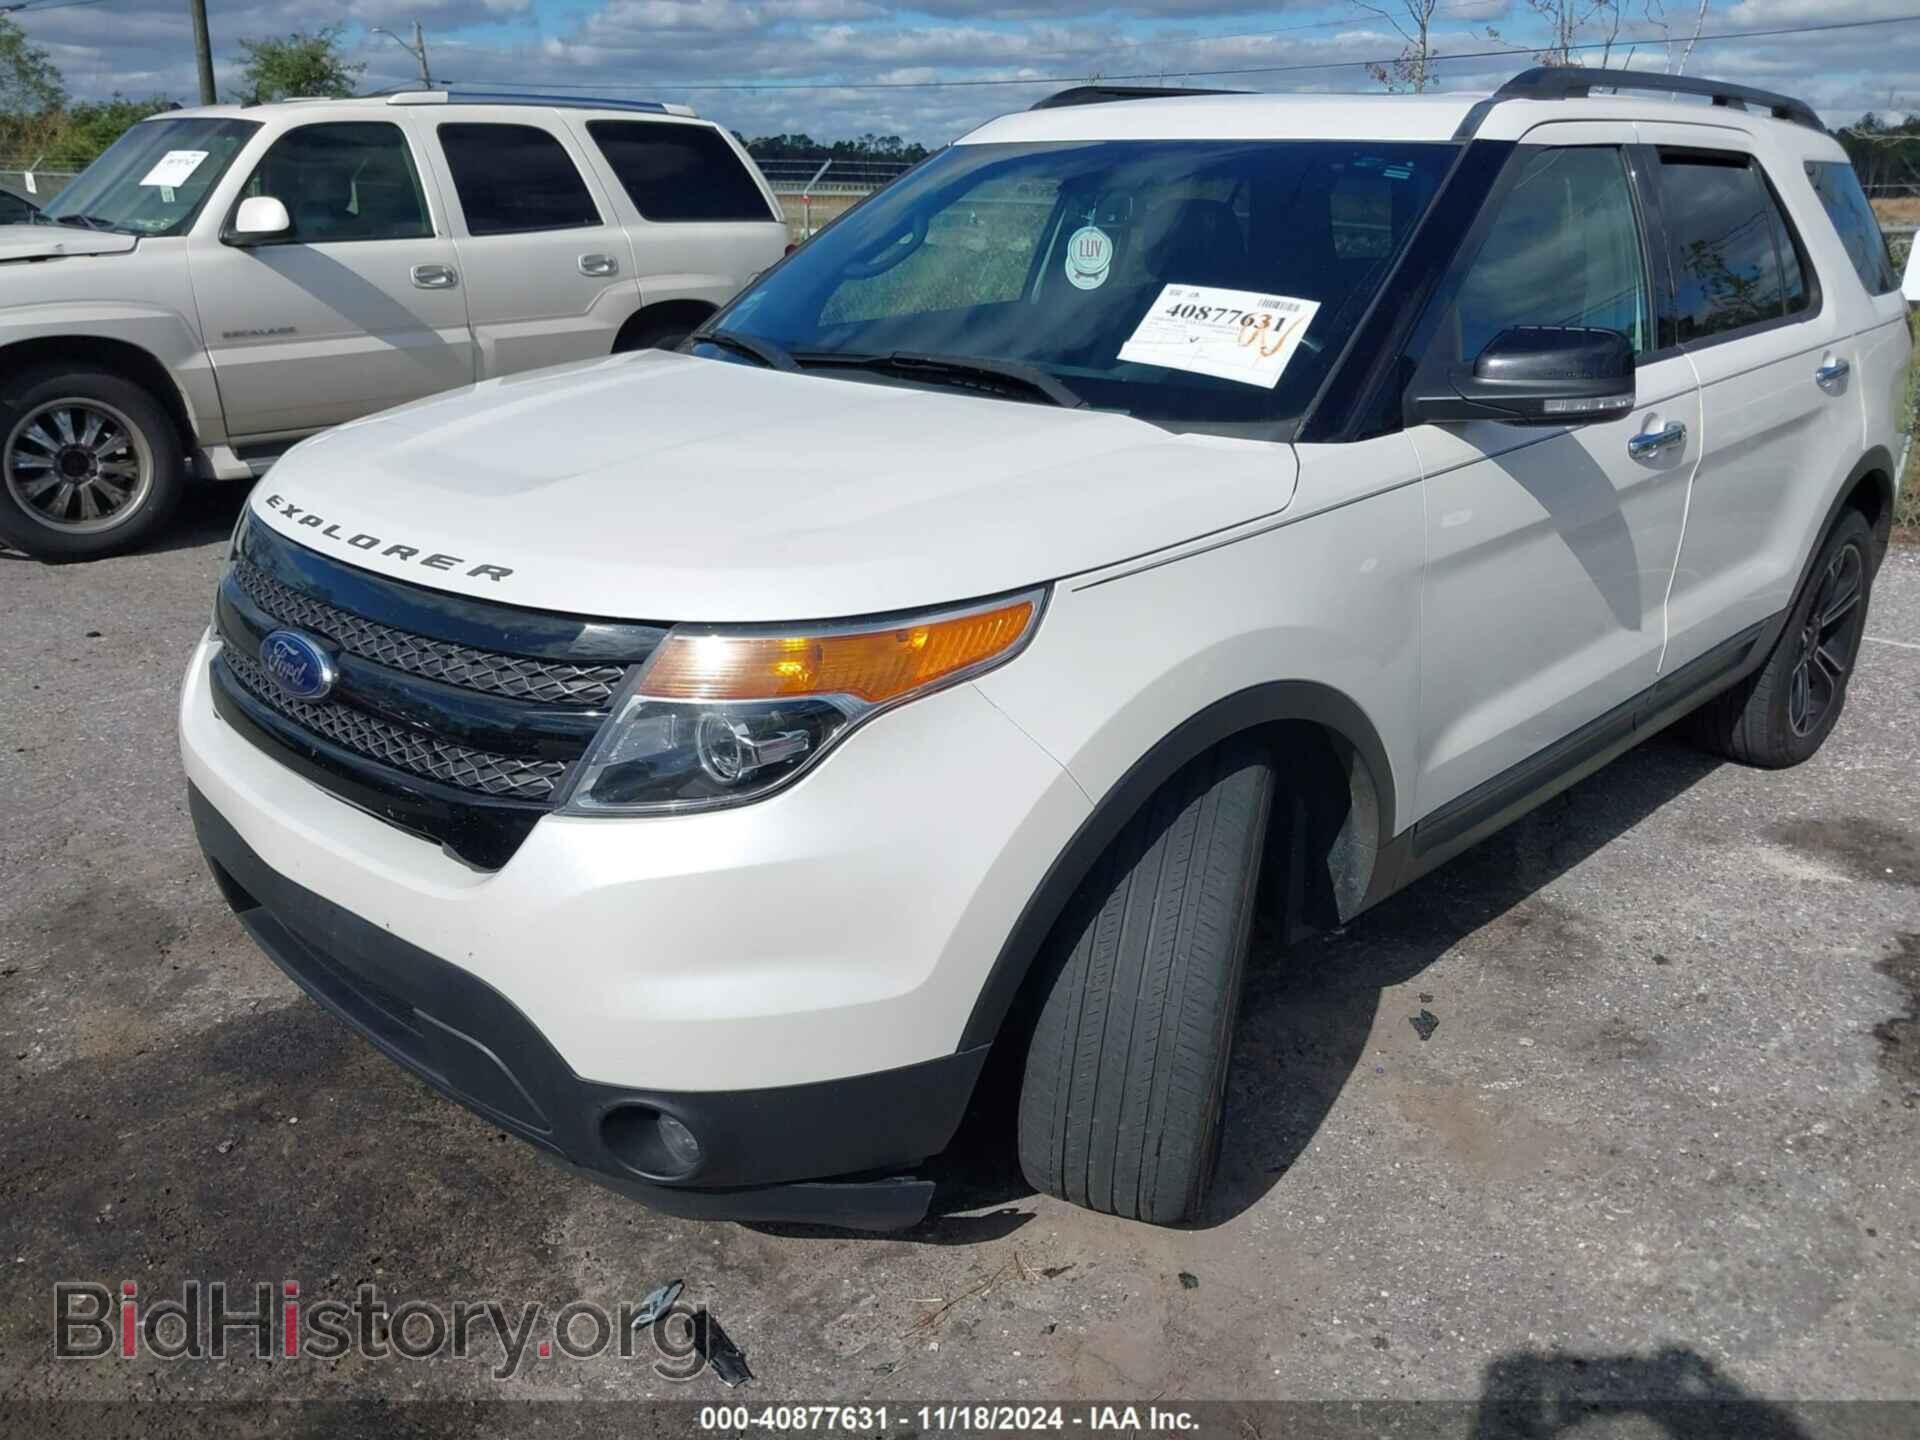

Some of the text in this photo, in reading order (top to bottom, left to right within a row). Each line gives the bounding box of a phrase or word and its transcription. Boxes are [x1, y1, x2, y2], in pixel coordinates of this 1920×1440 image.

[1079, 239, 1103, 258] LUV
[1165, 302, 1287, 333] 40877631
[265, 493, 515, 583] EXPLORER
[267, 639, 309, 688] Ford
